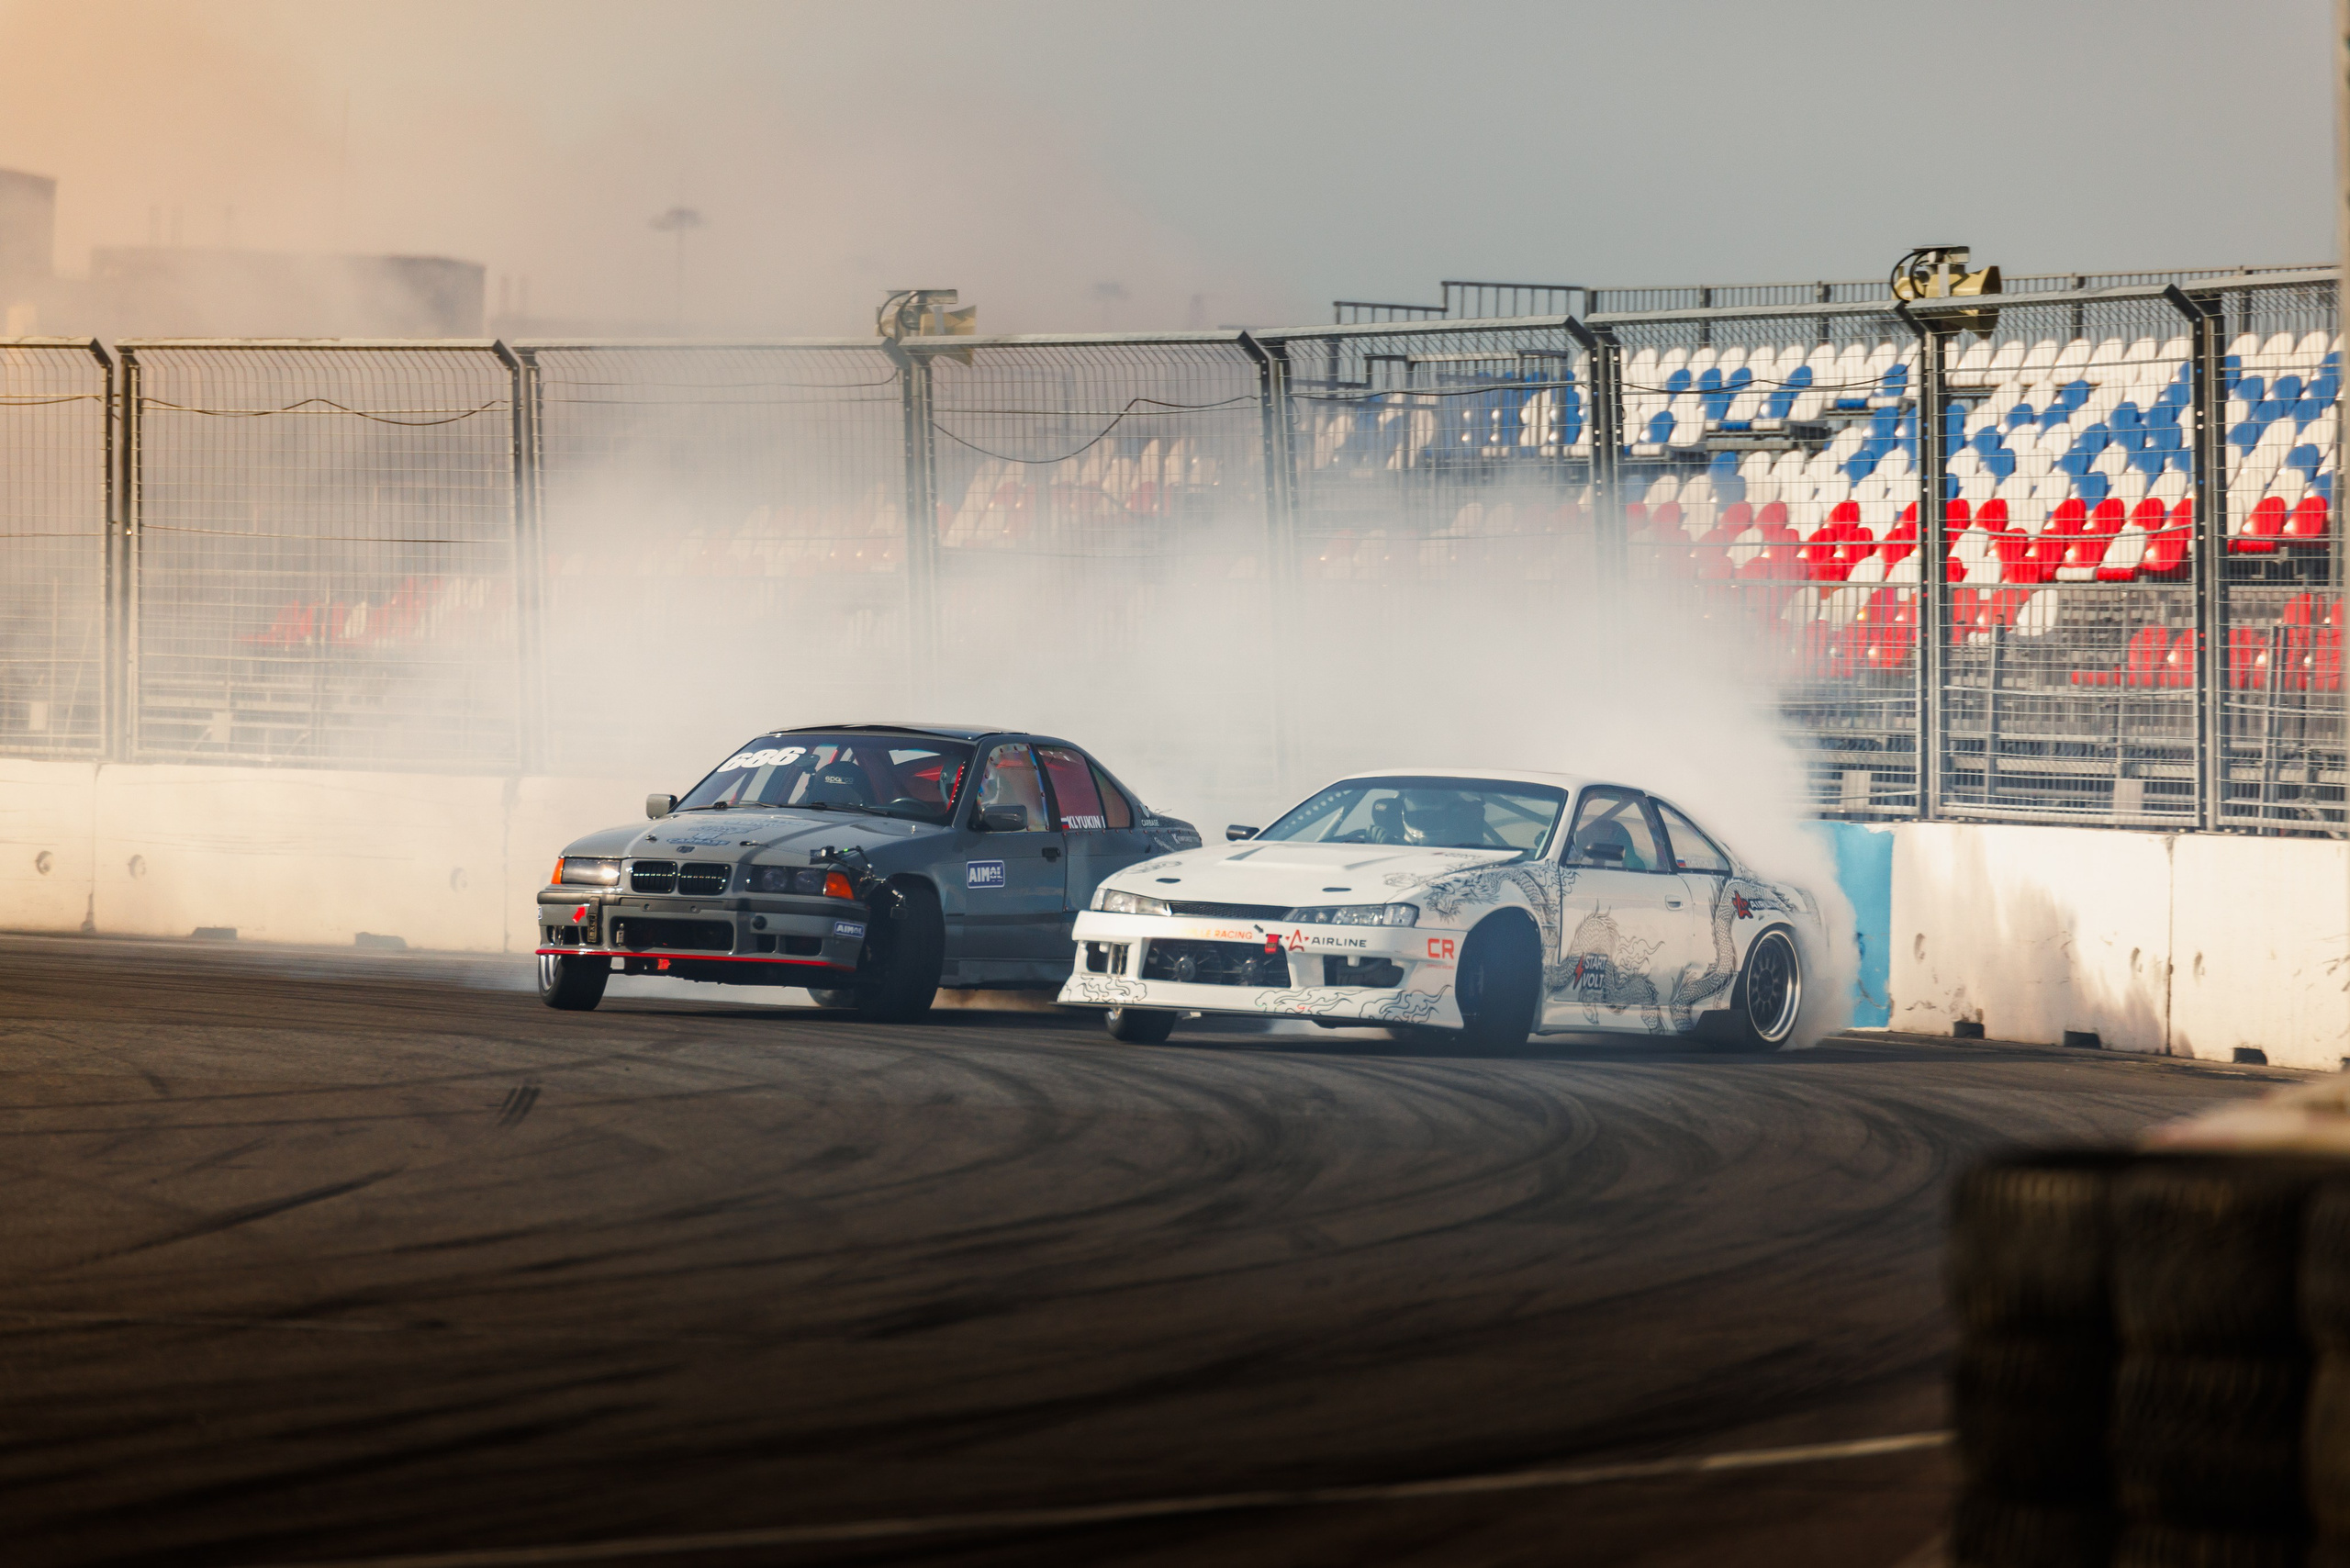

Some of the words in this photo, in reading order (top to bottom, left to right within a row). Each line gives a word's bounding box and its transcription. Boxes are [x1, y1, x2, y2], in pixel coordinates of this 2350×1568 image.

[717, 746, 807, 773] 686
[1066, 815, 1102, 829] KLYUKIN
[968, 867, 1002, 882] AIMOL
[1214, 929, 1253, 940] RACING
[1311, 935, 1367, 947] AIRLINE
[1427, 937, 1455, 959] CR
[1585, 956, 1607, 969] START
[1583, 973, 1605, 988] VOLT
